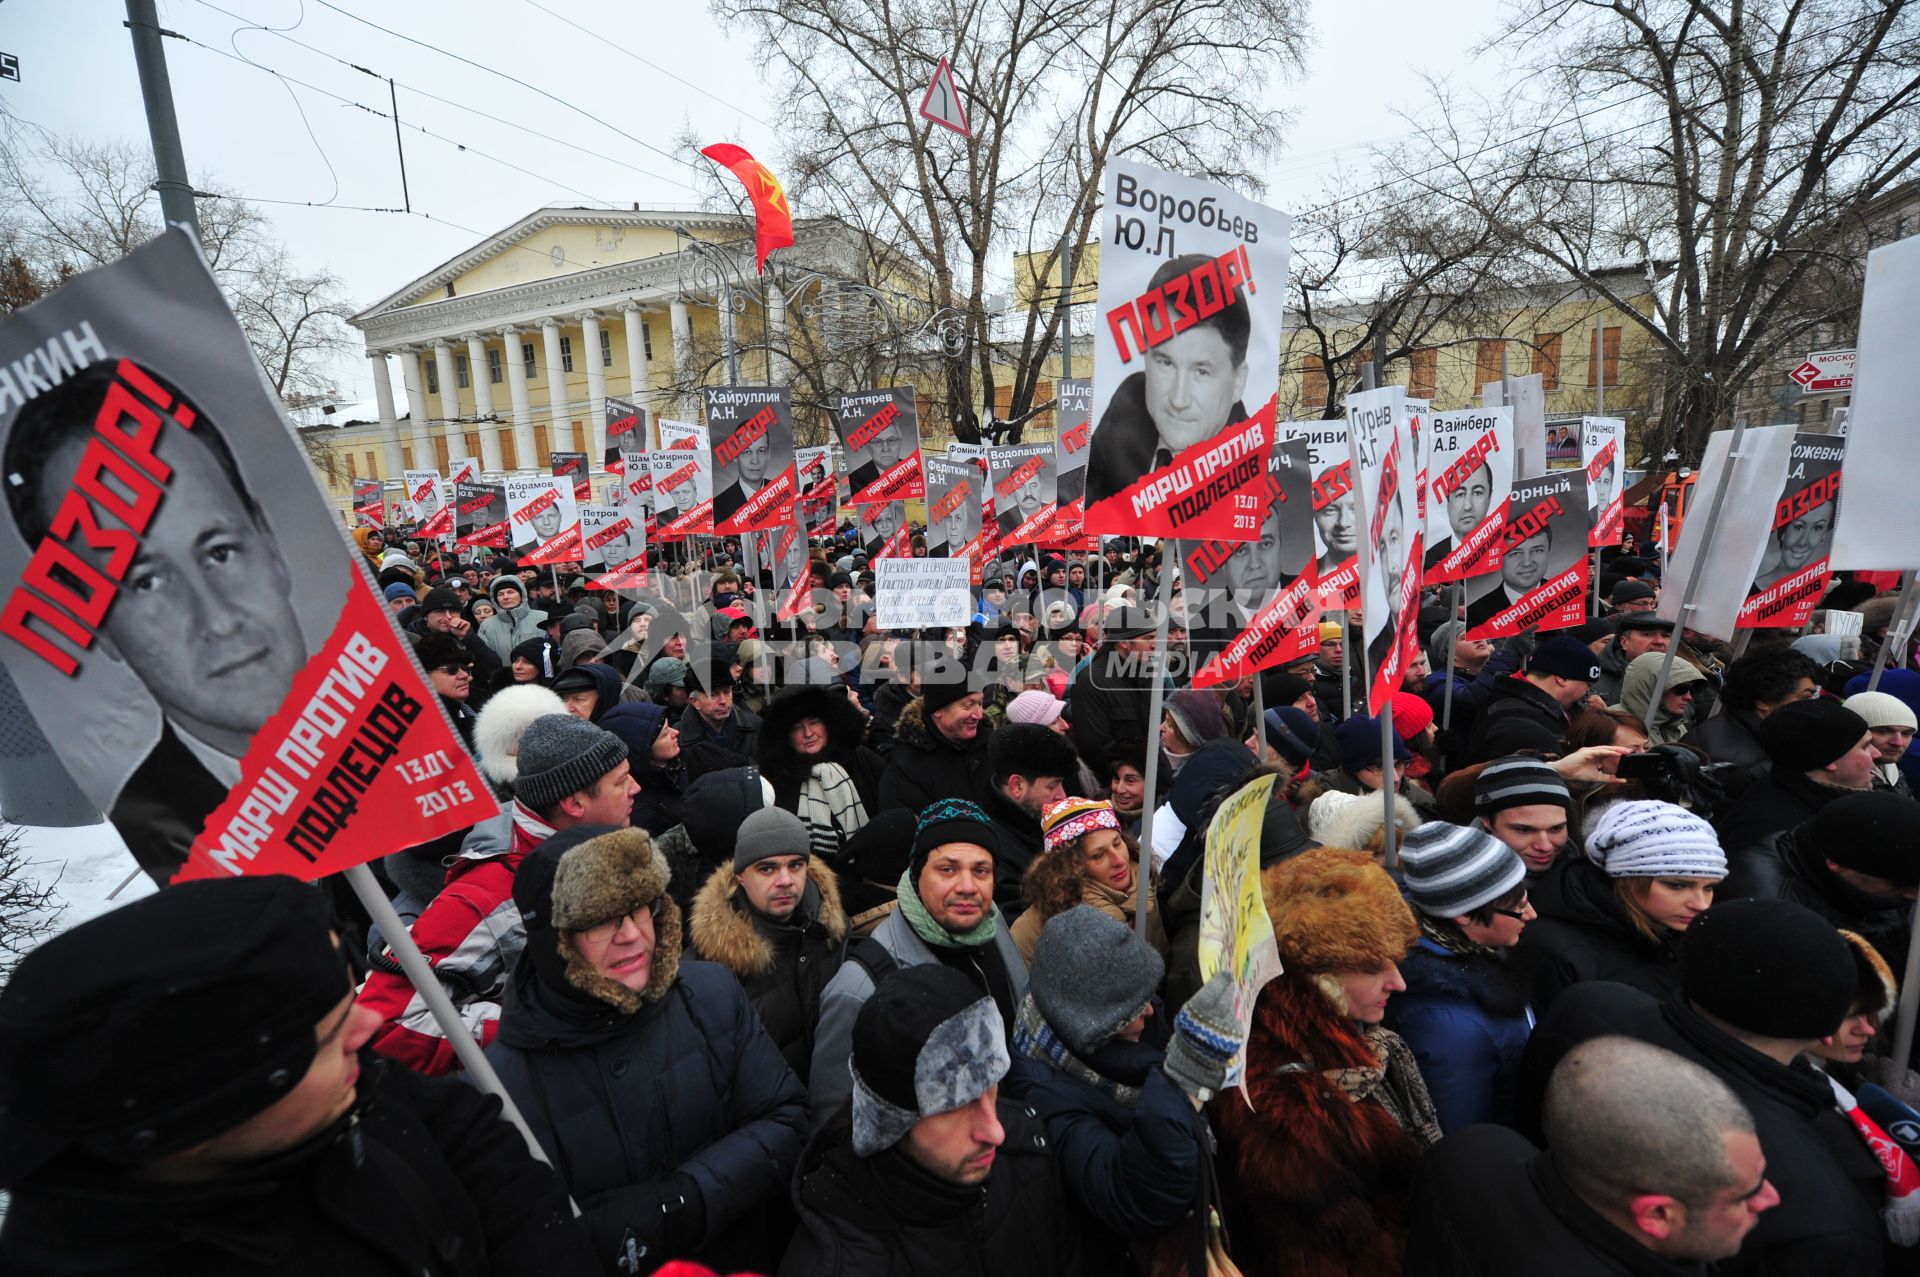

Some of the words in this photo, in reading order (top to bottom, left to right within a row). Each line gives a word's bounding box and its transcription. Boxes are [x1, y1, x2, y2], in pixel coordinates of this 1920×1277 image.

[1116, 173, 1258, 244] Воробьев
[1106, 243, 1256, 363] ПОЗОР!
[708, 390, 780, 406] Хайруллин
[710, 406, 738, 420] А.Н.
[840, 394, 893, 409] Дегтярев
[842, 408, 865, 419] А.Н.
[713, 405, 779, 468] ПОЗОР!
[846, 402, 902, 453] ПОЗОР!
[1434, 415, 1497, 434] Вайнберг
[652, 453, 694, 463] Смирнов
[949, 444, 977, 454] Фомин
[1434, 436, 1460, 452] А.В.
[653, 462, 674, 470] Ю.В.
[866, 478, 889, 497] МАРШ
[888, 457, 918, 480] ПРОТИВ
[927, 459, 969, 476] Федоткин
[928, 473, 947, 485] В.Н.
[992, 460, 1013, 469] В.П.
[996, 455, 1046, 499] ПОЗОР!
[1131, 465, 1193, 518] МАРШ
[1193, 423, 1265, 482] ПРОТИВ
[1431, 429, 1500, 505] ПОЗОР!
[458, 484, 495, 493] Васильев
[458, 490, 475, 498] Ю.В.
[508, 481, 554, 491] Абрамов
[509, 491, 530, 499] В.С.
[882, 468, 920, 498] ПОДЛЕЦОВ
[1168, 455, 1260, 528] ПОДЛЕЦОВ
[1510, 478, 1571, 503] орный
[0, 357, 196, 678] ПОЗОР!
[512, 488, 563, 526] ПОЗОР!
[583, 509, 619, 517] Петров
[671, 518, 689, 532] МАРШ
[688, 502, 713, 521] ПРОТИВ
[732, 502, 758, 528] МАРШ
[757, 475, 789, 507] ПРОТИВ
[749, 489, 792, 528] ПОДЛЕЦОВ
[1234, 495, 1257, 509] 13.01
[1771, 471, 1841, 533] ОЗОР
[584, 518, 603, 526] В.А.
[585, 518, 634, 551] ПОЗОР!
[1014, 521, 1035, 539] МАРШ
[1233, 515, 1255, 529] 2013
[531, 545, 552, 561] МАРШ
[551, 529, 577, 551] ПРОТИВ
[1443, 545, 1471, 574] МАРШ
[1470, 512, 1503, 547] ПРОТИВ
[617, 559, 643, 578] ПРОТИВ
[1491, 603, 1530, 631] МАРШ
[1530, 570, 1581, 608] ПРОТИВ
[1740, 587, 1776, 619] МАРШ
[1779, 561, 1826, 597] ПРОТИВ
[1757, 579, 1822, 622] ПОДЛЕЦОВ
[1516, 585, 1582, 631] ПОДЛЕЦОВ
[1562, 613, 1580, 622] 2013
[1221, 627, 1262, 670] МАРШ
[1260, 579, 1311, 632] ПРОТИВ
[1249, 599, 1315, 666] ПОДЛЕЦОВ
[208, 767, 299, 876] МАРШ
[275, 631, 389, 780] ПРОТИВ
[395, 750, 454, 785] 13.01
[284, 682, 423, 864] ПОДЛЕЦОВ
[415, 780, 475, 818] 2013
